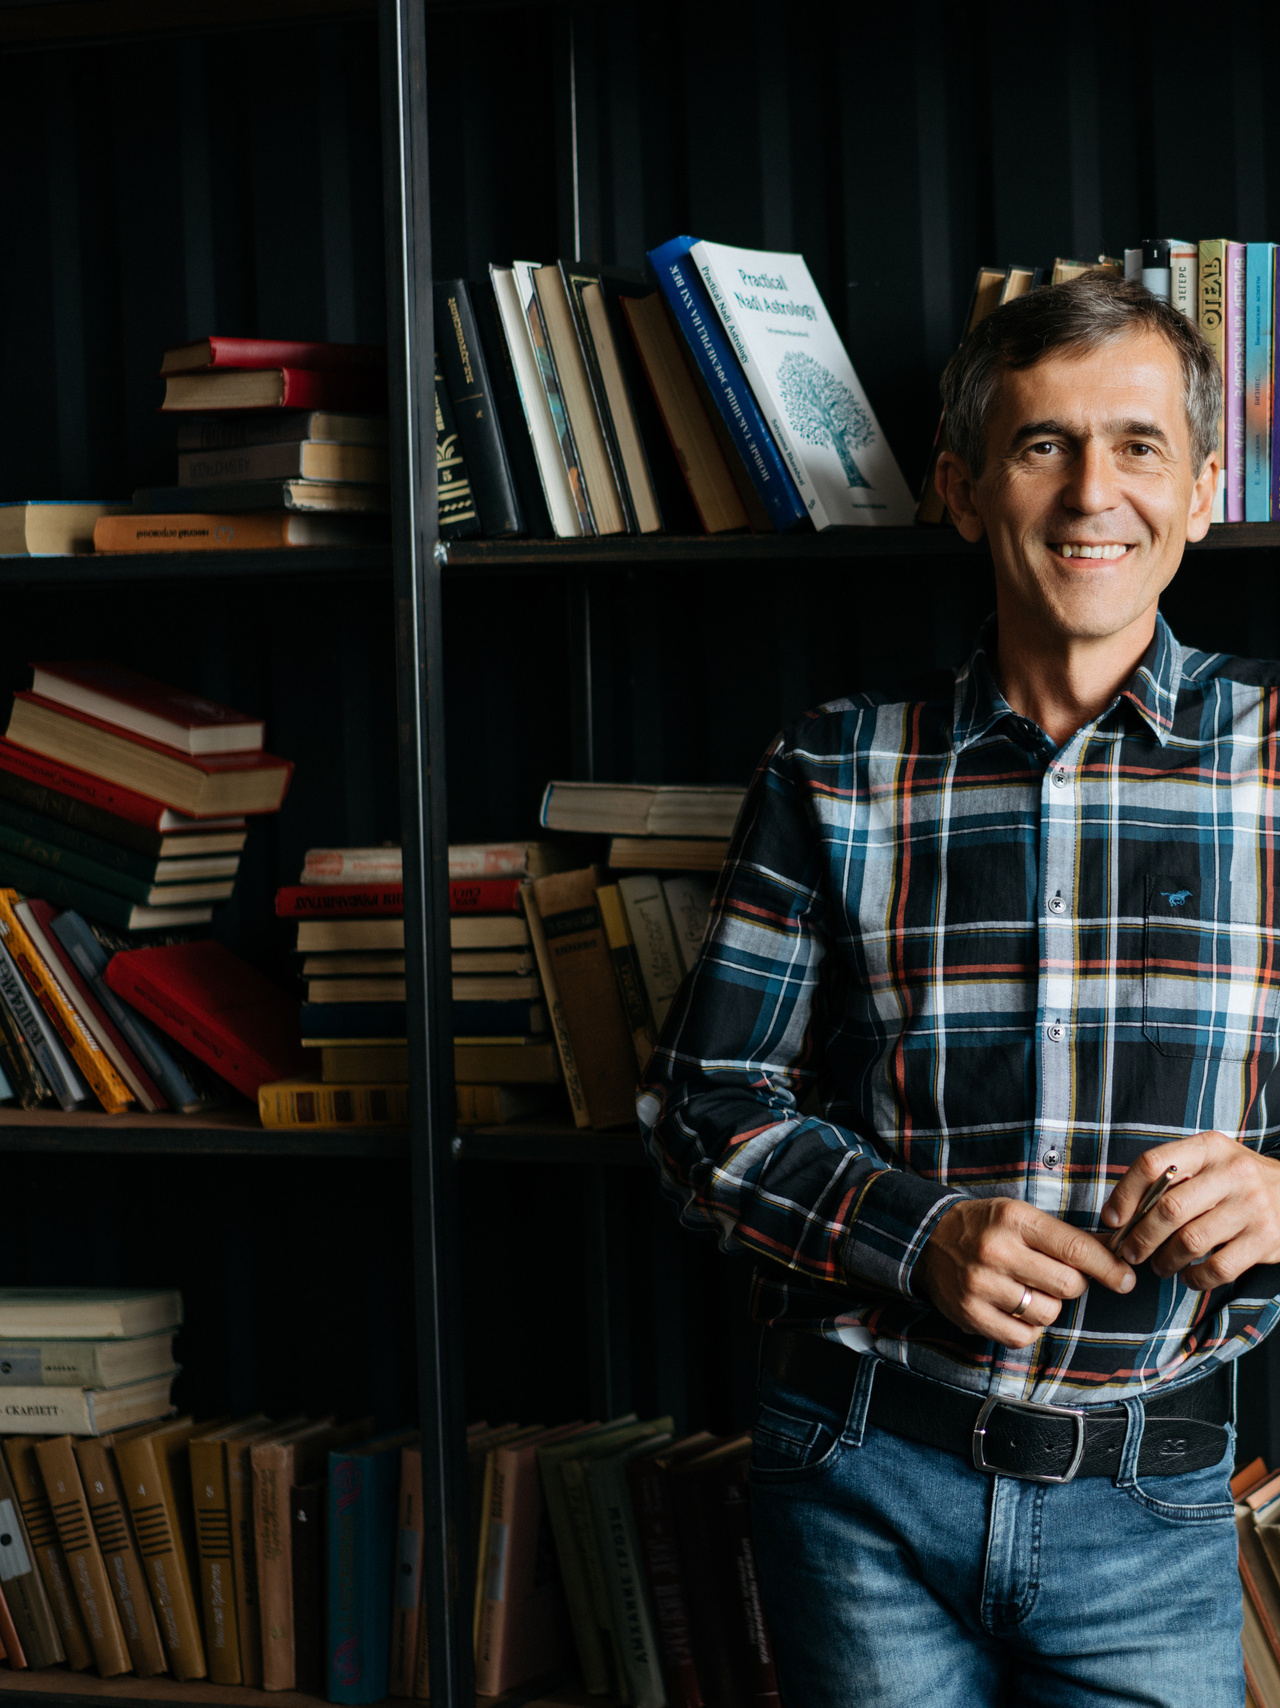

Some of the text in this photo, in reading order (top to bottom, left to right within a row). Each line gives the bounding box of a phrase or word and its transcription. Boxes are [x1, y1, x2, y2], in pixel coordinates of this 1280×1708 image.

[668, 264, 685, 288] ВЕК
[738, 269, 788, 291] Practical
[1178, 266, 1187, 300] ЗЕГЕРС
[1201, 258, 1221, 330] ОТЕЛЬ
[688, 307, 702, 326] НА
[700, 265, 750, 365] Practical Nadi Astrology
[734, 292, 818, 321] Nadi Astrology
[696, 324, 730, 386] ЭФЕМЕРИД
[723, 385, 753, 440] ТАБЛИЦЫ
[747, 440, 770, 482] НОВЫЕ
[5, 1405, 59, 1415] СКАРЛЕТТ
[608, 1506, 646, 1663] ДЫХАНИЕ ГРОЗЫ
